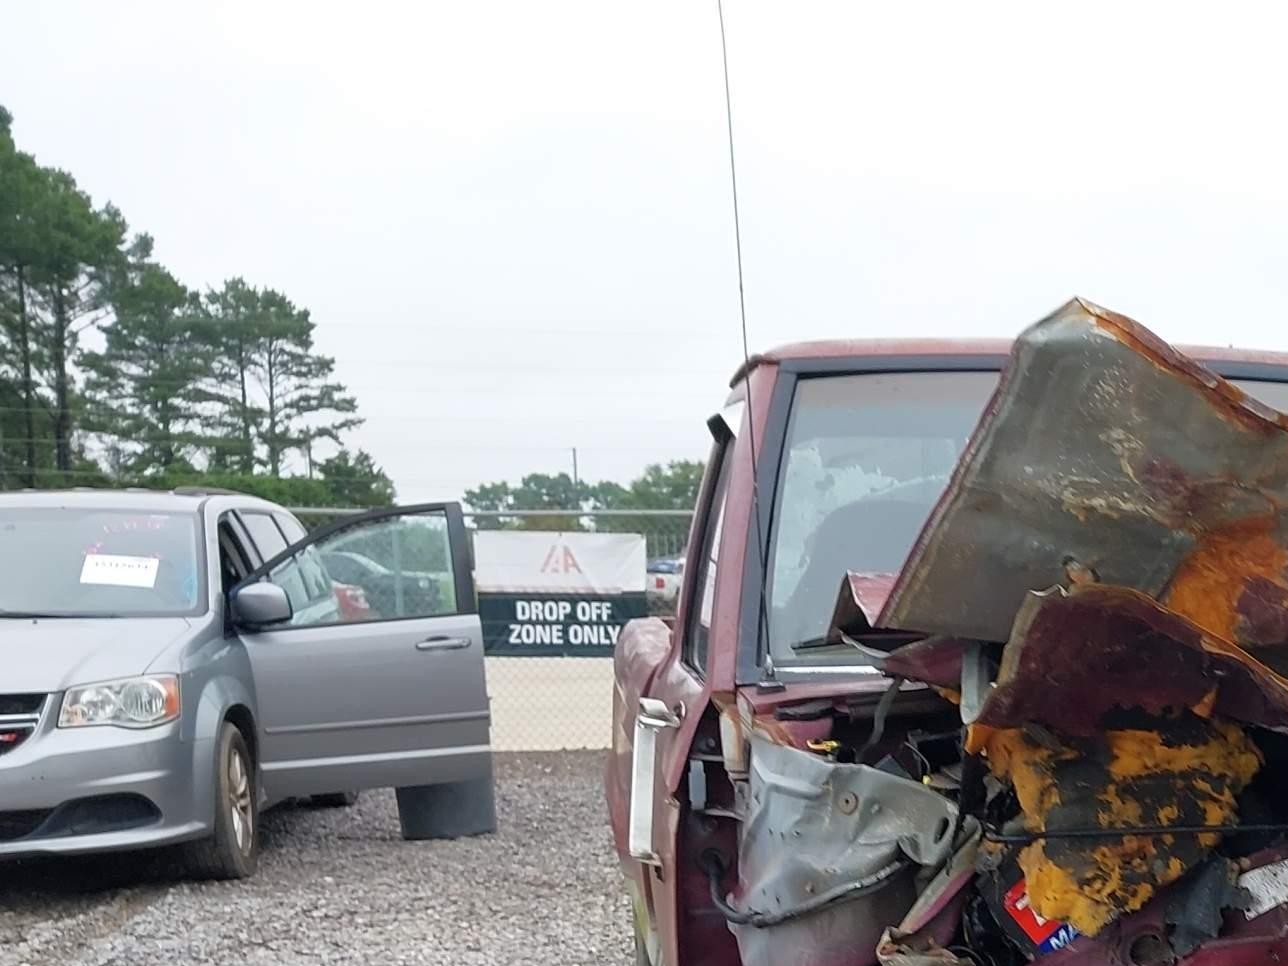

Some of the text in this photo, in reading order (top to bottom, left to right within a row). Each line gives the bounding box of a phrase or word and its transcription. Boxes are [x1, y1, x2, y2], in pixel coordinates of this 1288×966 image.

[515, 600, 612, 622] DROP OFF
[508, 624, 621, 645] ZONE ONLY
